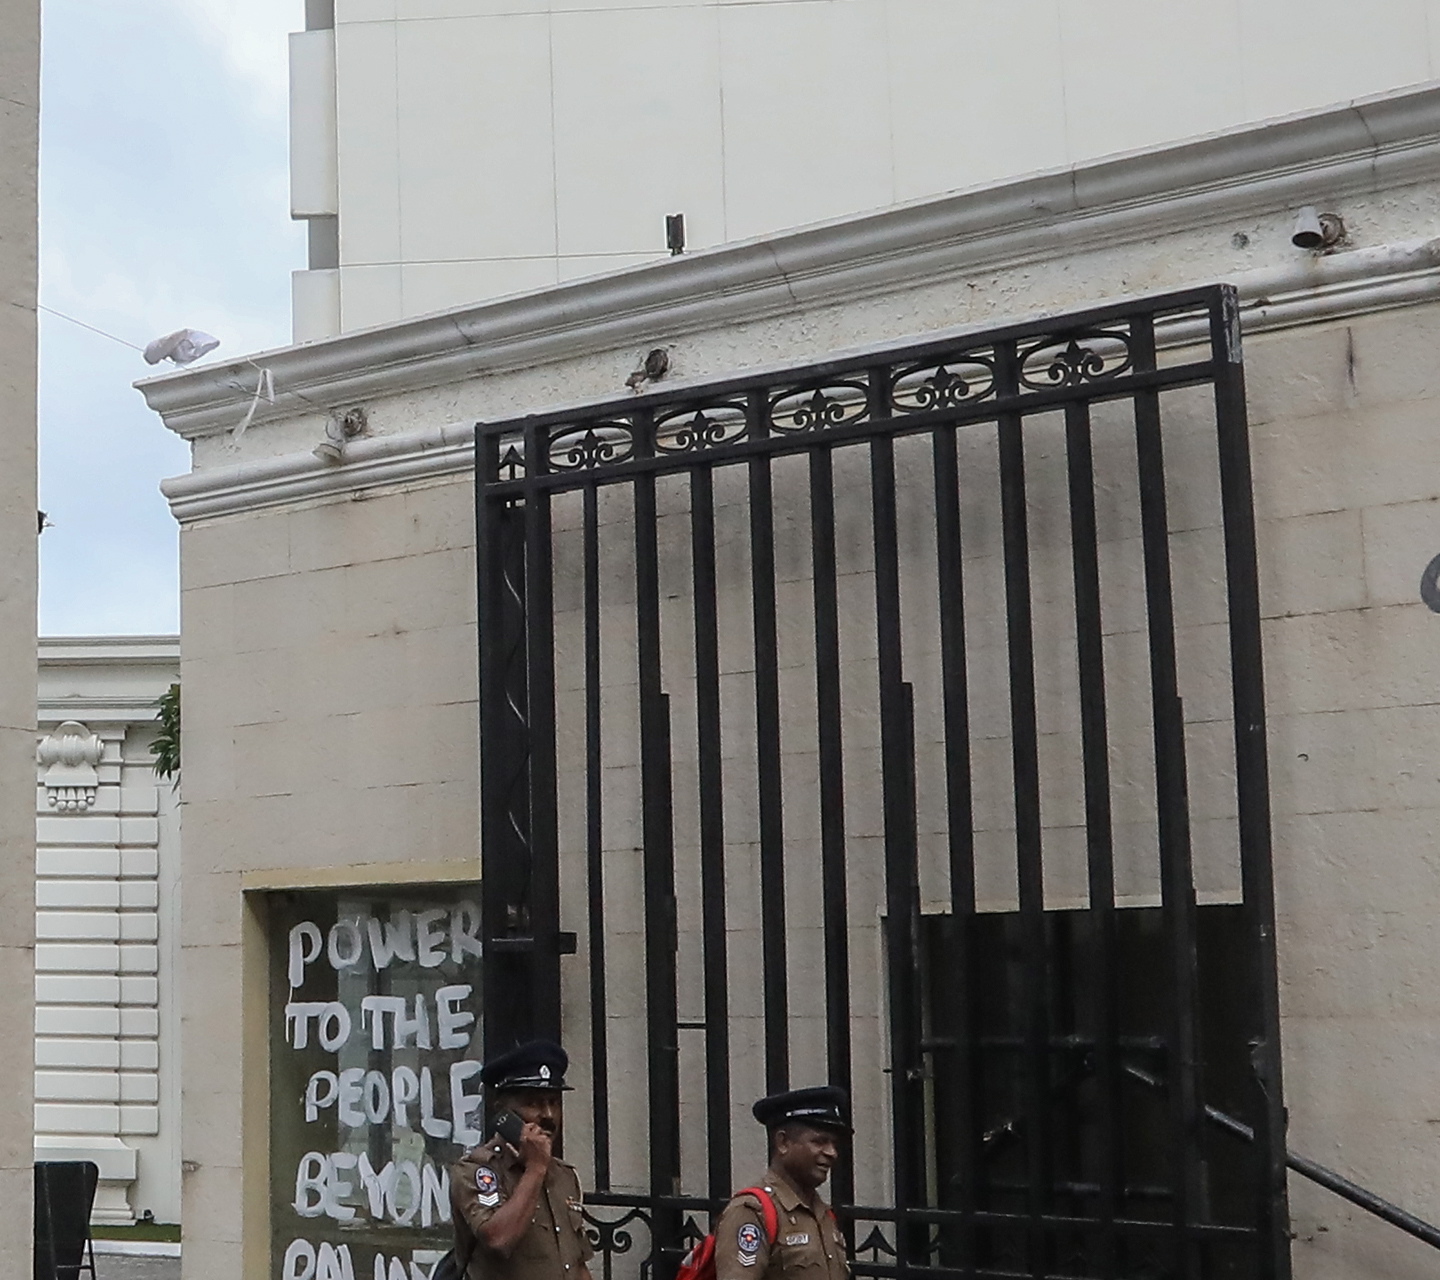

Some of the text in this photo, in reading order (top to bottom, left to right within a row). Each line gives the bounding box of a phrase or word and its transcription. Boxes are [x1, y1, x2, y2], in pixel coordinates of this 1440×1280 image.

[287, 900, 484, 988] POWER
[285, 984, 475, 1054] TO THE
[304, 1059, 484, 1148] PEOPLE
[290, 1150, 453, 1228] BEYON
